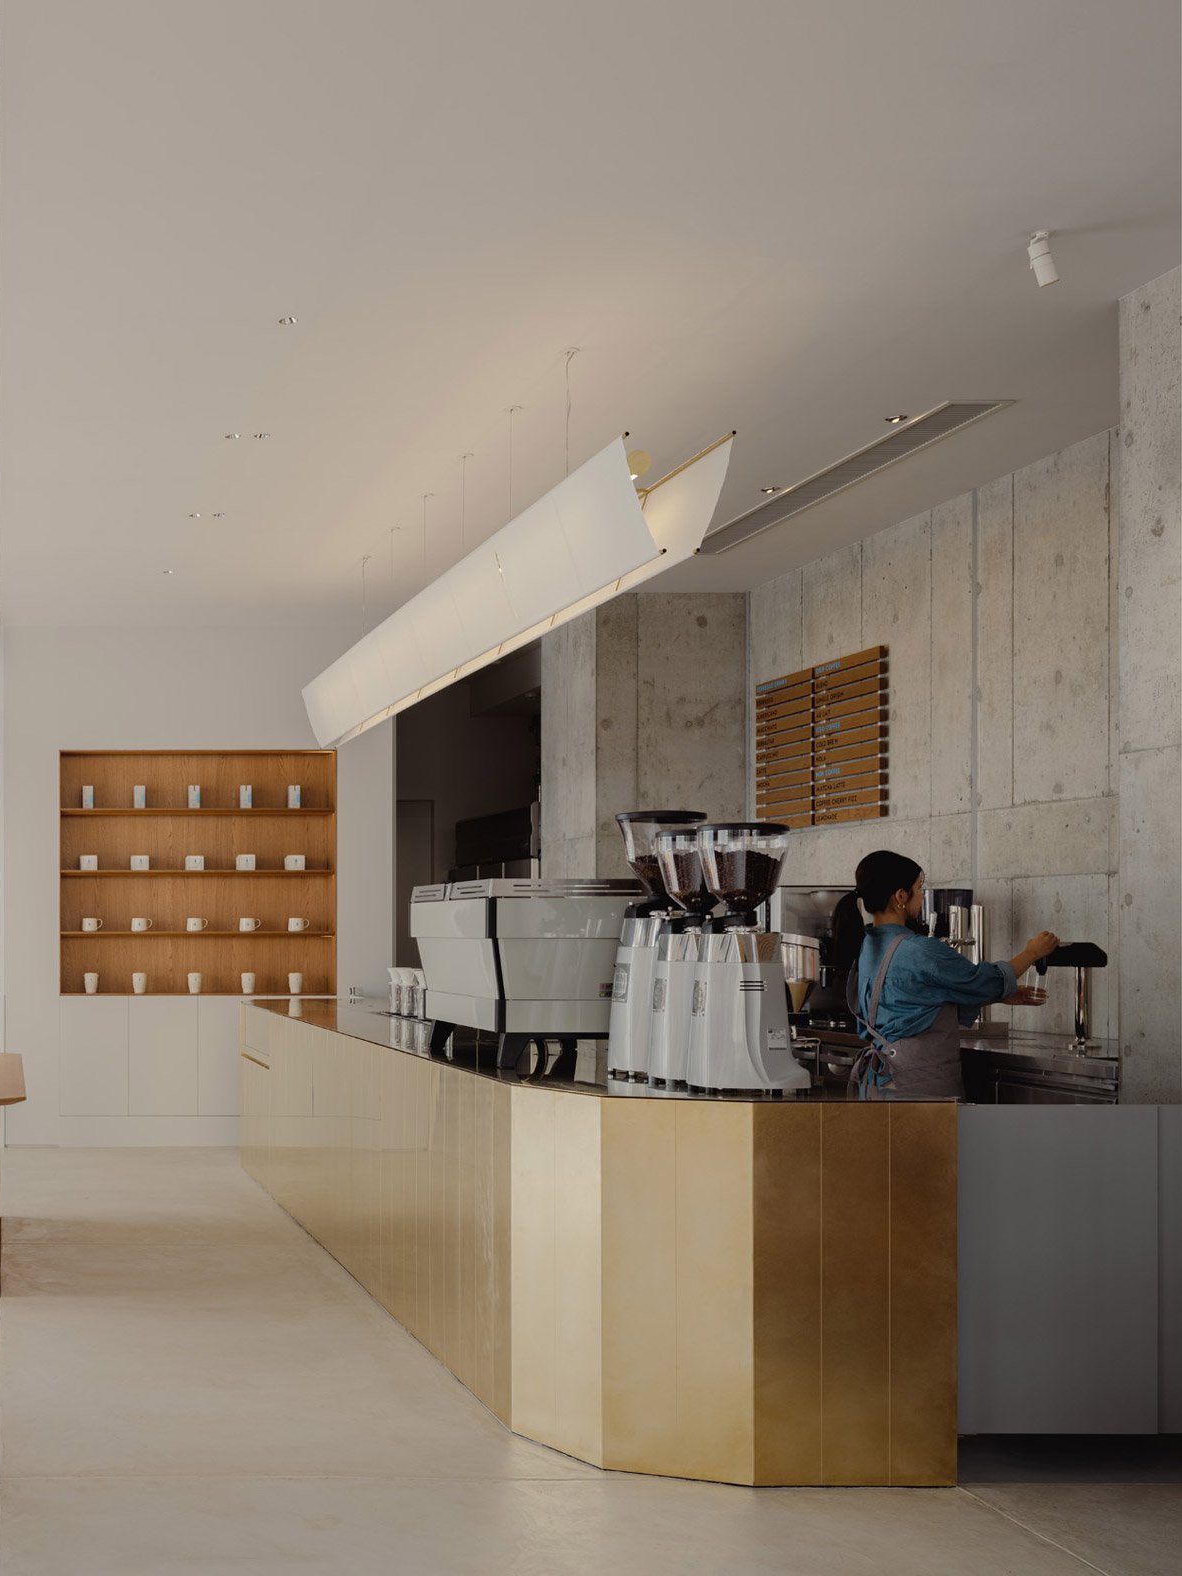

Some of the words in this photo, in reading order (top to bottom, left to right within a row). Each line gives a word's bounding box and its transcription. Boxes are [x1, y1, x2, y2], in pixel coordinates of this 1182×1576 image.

[816, 740, 826, 748] COLD
[833, 782, 846, 790] LATTE
[816, 799, 830, 807] COFFEE
[831, 797, 847, 805] CHERRY
[816, 813, 838, 821] LEMONADE
